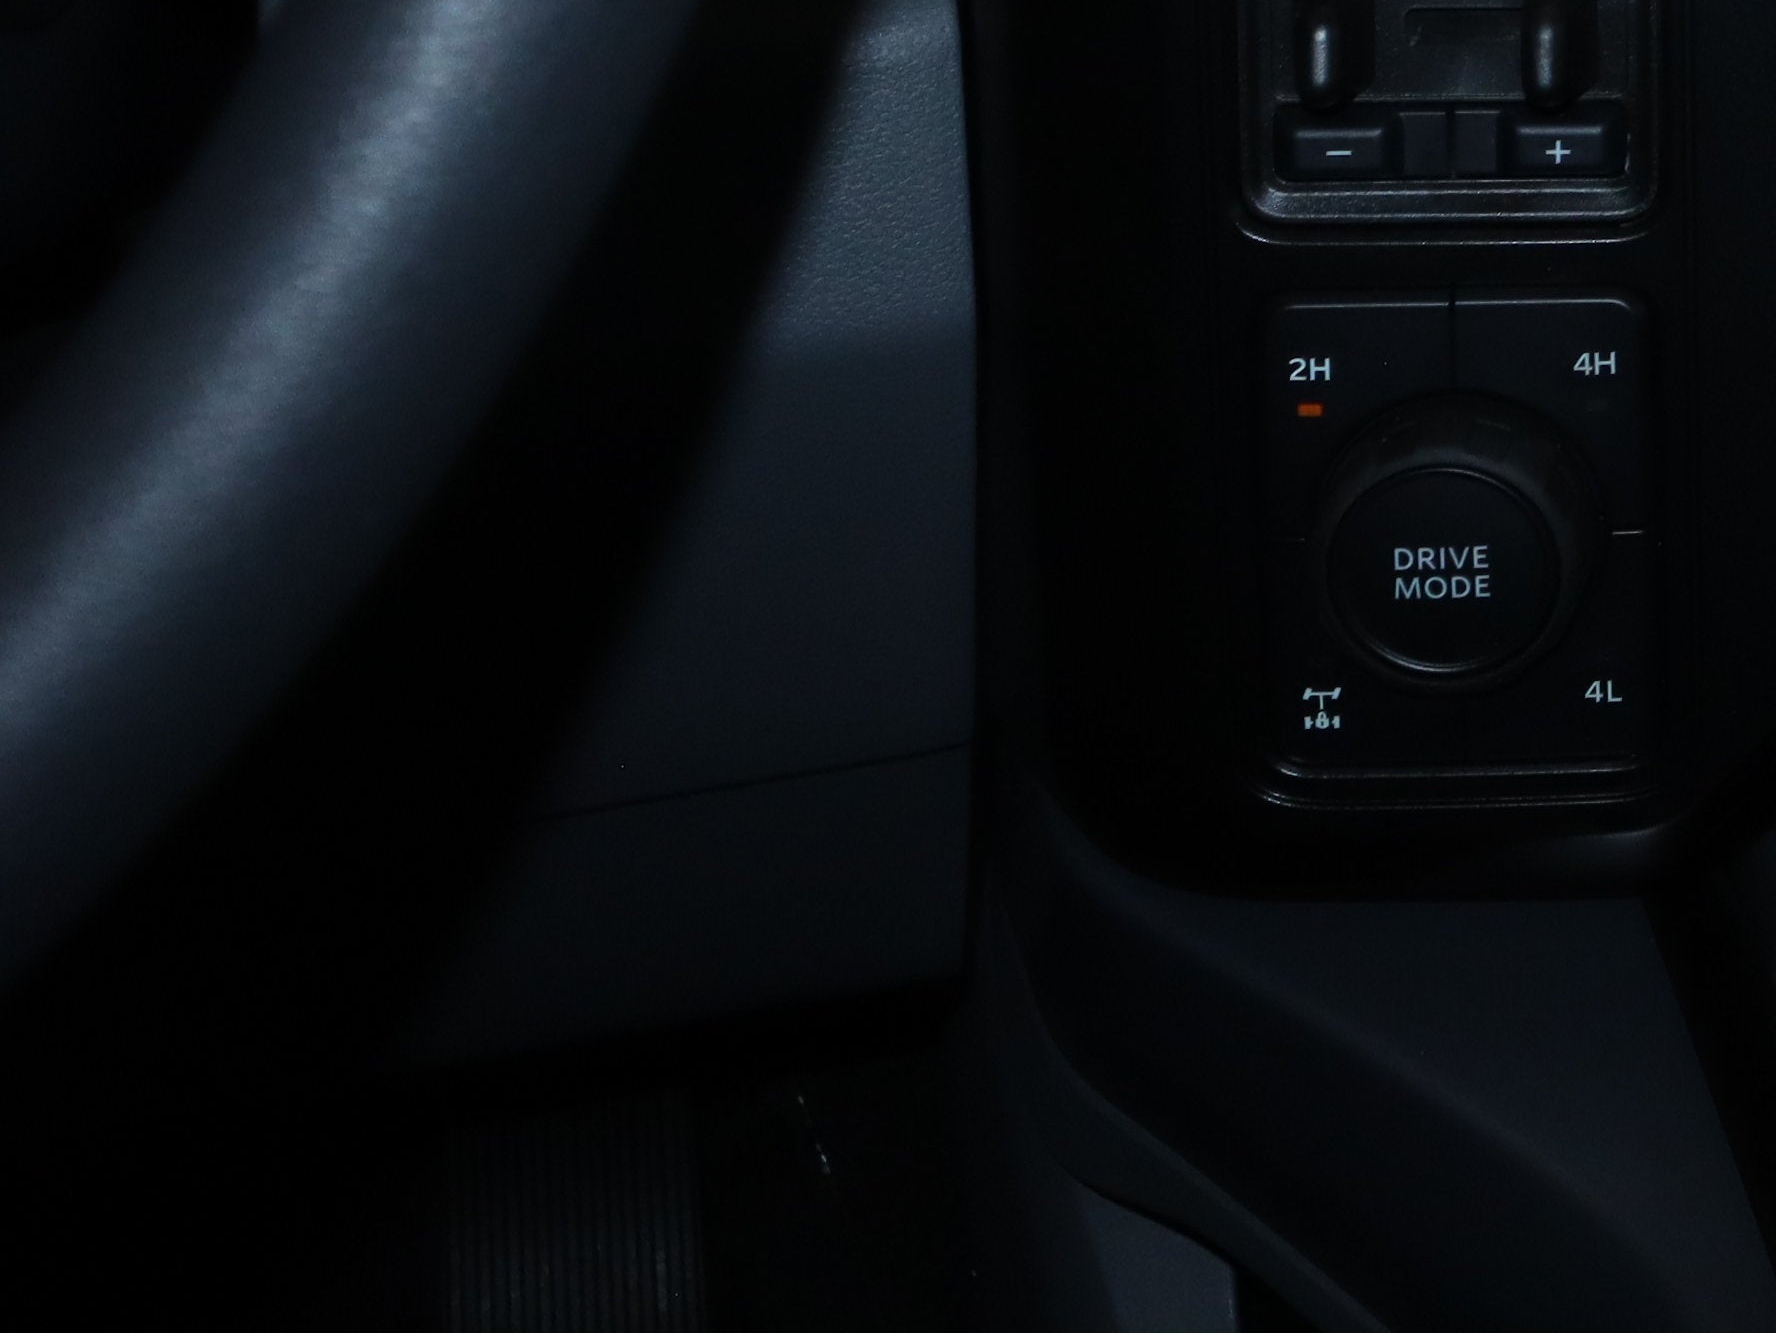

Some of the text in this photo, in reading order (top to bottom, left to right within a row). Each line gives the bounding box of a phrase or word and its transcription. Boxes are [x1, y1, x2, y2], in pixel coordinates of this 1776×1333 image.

[1288, 358, 1332, 383] 2H
[1573, 351, 1617, 377] 4H
[1393, 546, 1490, 572] DRIVE
[1394, 575, 1491, 601] MODE
[1585, 681, 1622, 705] 4L
